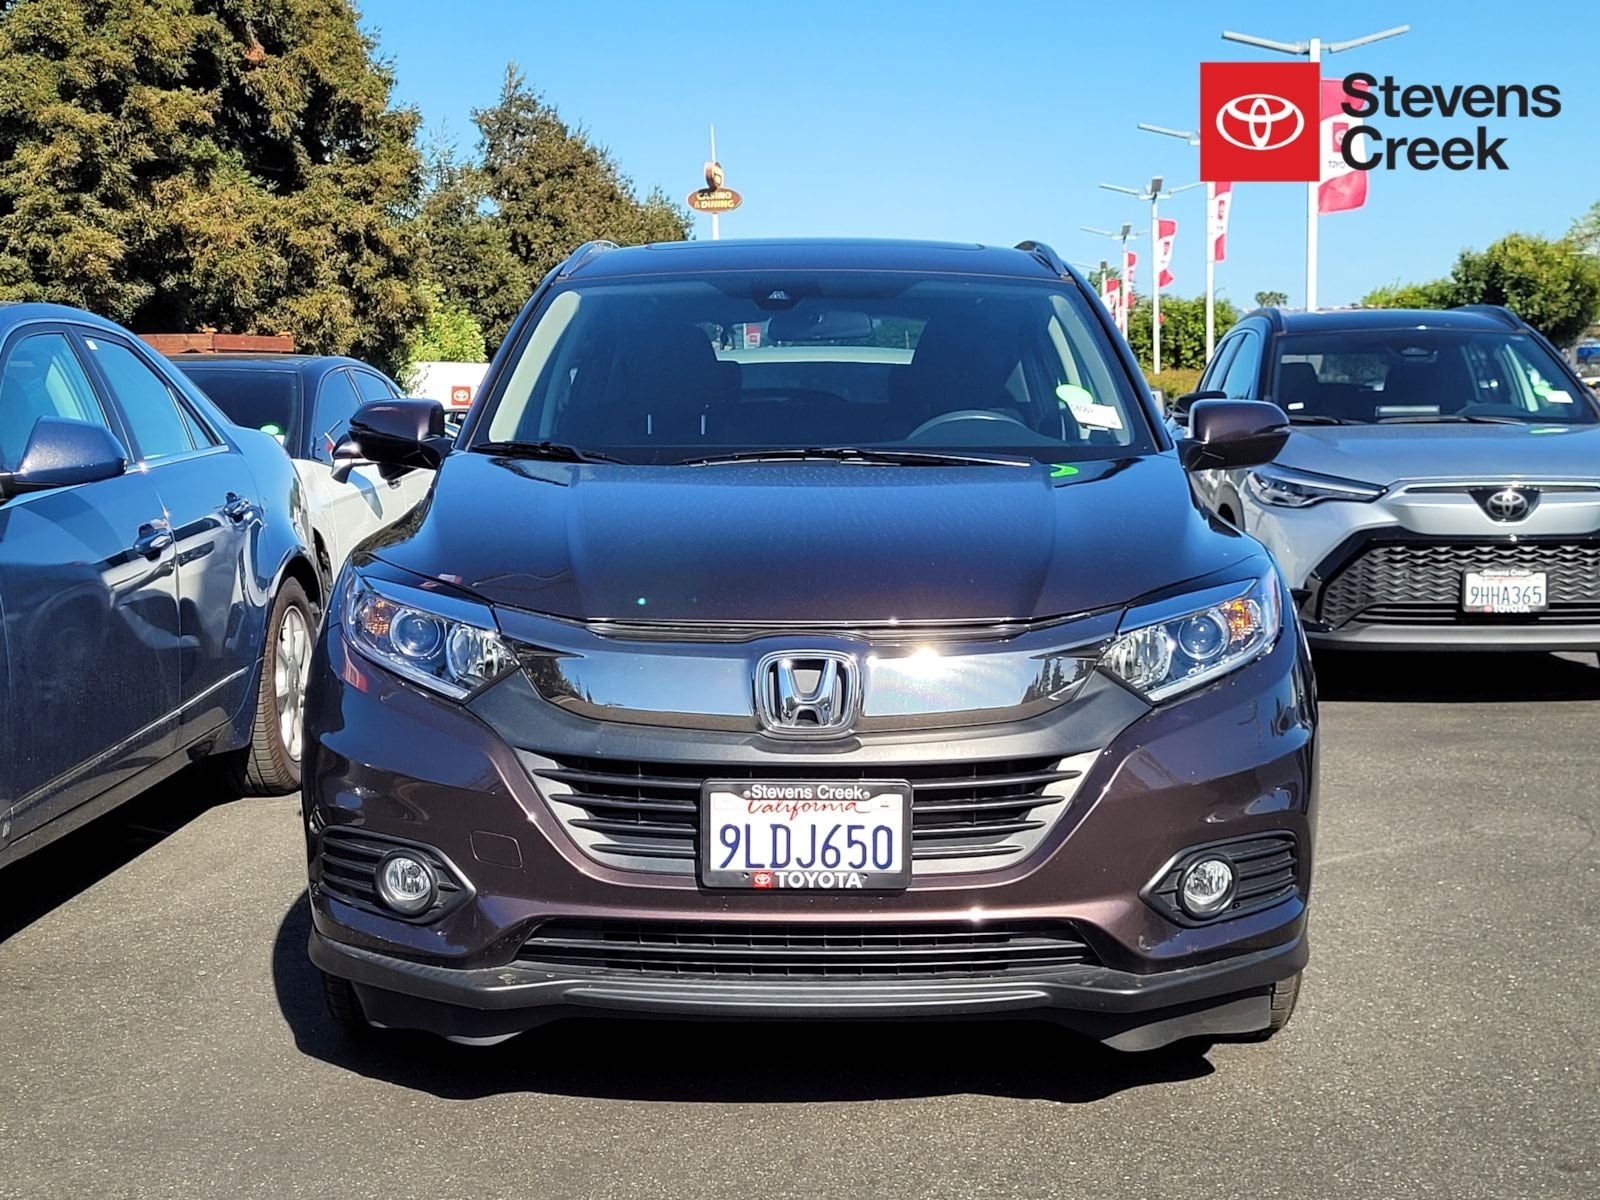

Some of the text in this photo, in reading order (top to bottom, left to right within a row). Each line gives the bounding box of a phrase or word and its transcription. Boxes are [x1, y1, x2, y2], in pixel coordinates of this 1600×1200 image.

[696, 191, 732, 201] CASINO
[700, 200, 735, 209] DINING
[1471, 586, 1542, 606] 9HHA365
[751, 784, 863, 800] Stevens Creek
[747, 799, 871, 821] California
[719, 823, 893, 870] 9LDJ650
[775, 871, 863, 889] TOYOTA
